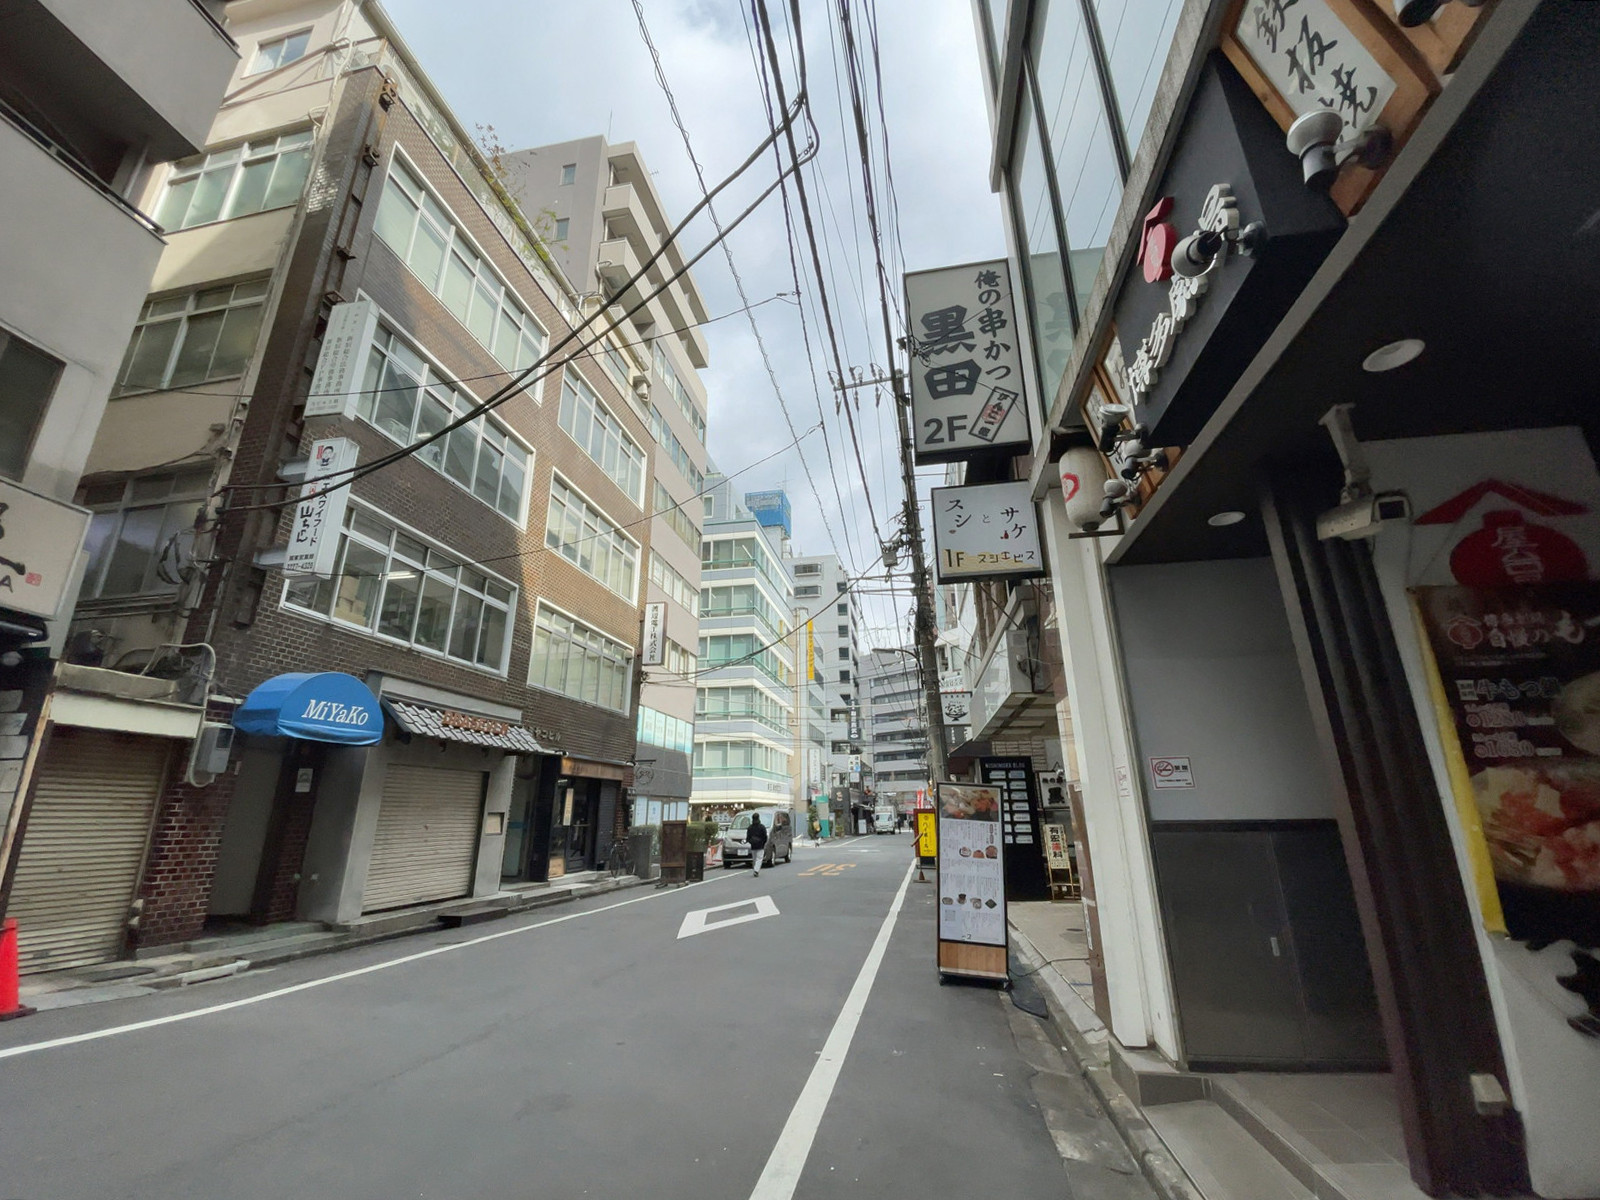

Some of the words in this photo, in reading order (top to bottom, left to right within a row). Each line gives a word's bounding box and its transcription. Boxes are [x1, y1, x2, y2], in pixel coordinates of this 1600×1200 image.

[974, 270, 1011, 380] 俺の串かつ
[920, 305, 982, 400] 黒田
[924, 415, 968, 444] 2F
[945, 500, 972, 528] スシ
[982, 514, 991, 524] と
[1000, 507, 1027, 539] サケ
[945, 549, 964, 567] 1F
[978, 551, 1034, 564] スシエビス
[301, 699, 369, 726] MiYaKo
